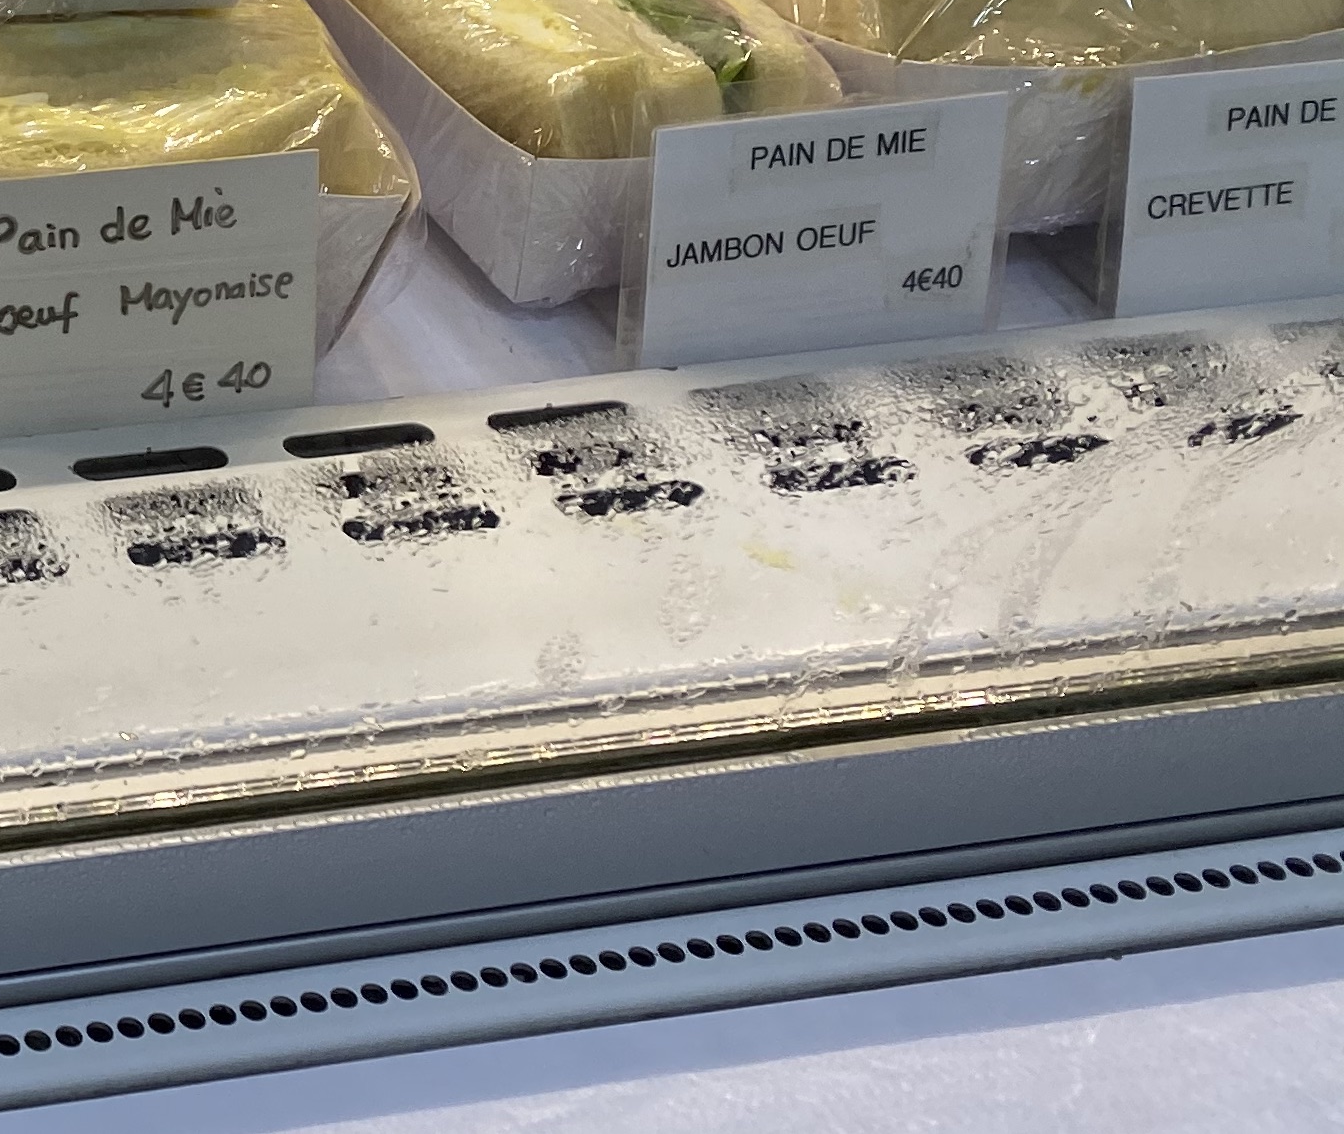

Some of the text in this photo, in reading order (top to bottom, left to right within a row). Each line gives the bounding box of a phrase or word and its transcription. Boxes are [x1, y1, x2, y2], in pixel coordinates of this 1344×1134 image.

[1227, 97, 1338, 132] PAIN DE
[750, 127, 928, 171] PAIN DE MIE
[1147, 180, 1295, 220] CREVETTE
[99, 205, 153, 244] de
[666, 219, 877, 269] JAMBON OEUF
[901, 264, 964, 294] 4€40
